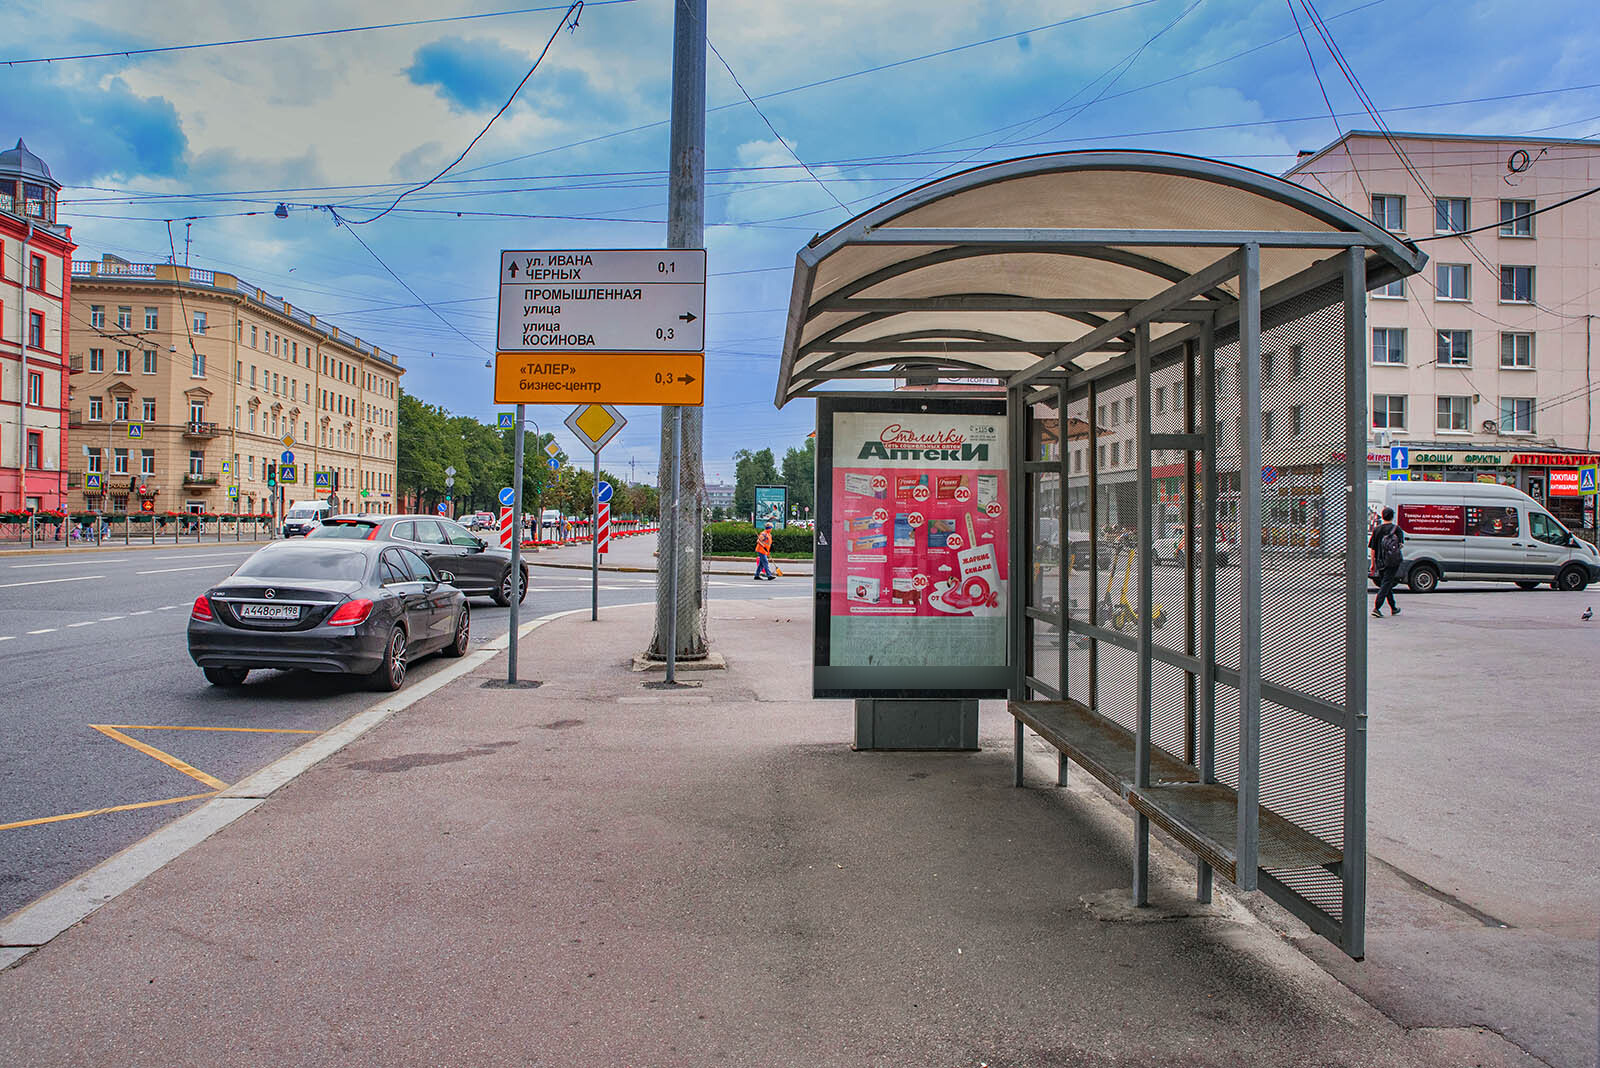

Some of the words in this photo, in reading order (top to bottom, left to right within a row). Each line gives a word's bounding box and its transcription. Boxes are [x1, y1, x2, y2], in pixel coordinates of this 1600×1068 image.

[526, 256, 544, 268] ул.
[548, 255, 593, 266] ИВАНА
[526, 269, 582, 280] ЧЕРНЫХ
[658, 262, 676, 275] 0,1
[524, 288, 642, 300] ПРОМЫШЛЕННАЯ
[523, 304, 561, 316] улица
[522, 322, 560, 334] улица
[522, 334, 595, 346] КОСИНОВА
[656, 328, 674, 342] 0,3
[520, 364, 576, 375] «ТАЛЕР»
[655, 372, 674, 386] 0,3
[519, 379, 601, 392] бизнес-центр
[880, 424, 967, 443] Столички
[1416, 454, 1453, 463] ОВОЩИ
[1464, 454, 1501, 464] ФРУКТЫ
[1550, 473, 1578, 481] ПОКУПАЕМ
[962, 553, 990, 564] ЖАРКИЕ
[964, 563, 992, 574] СКИДКИ
[284, 606, 298, 614] 198
